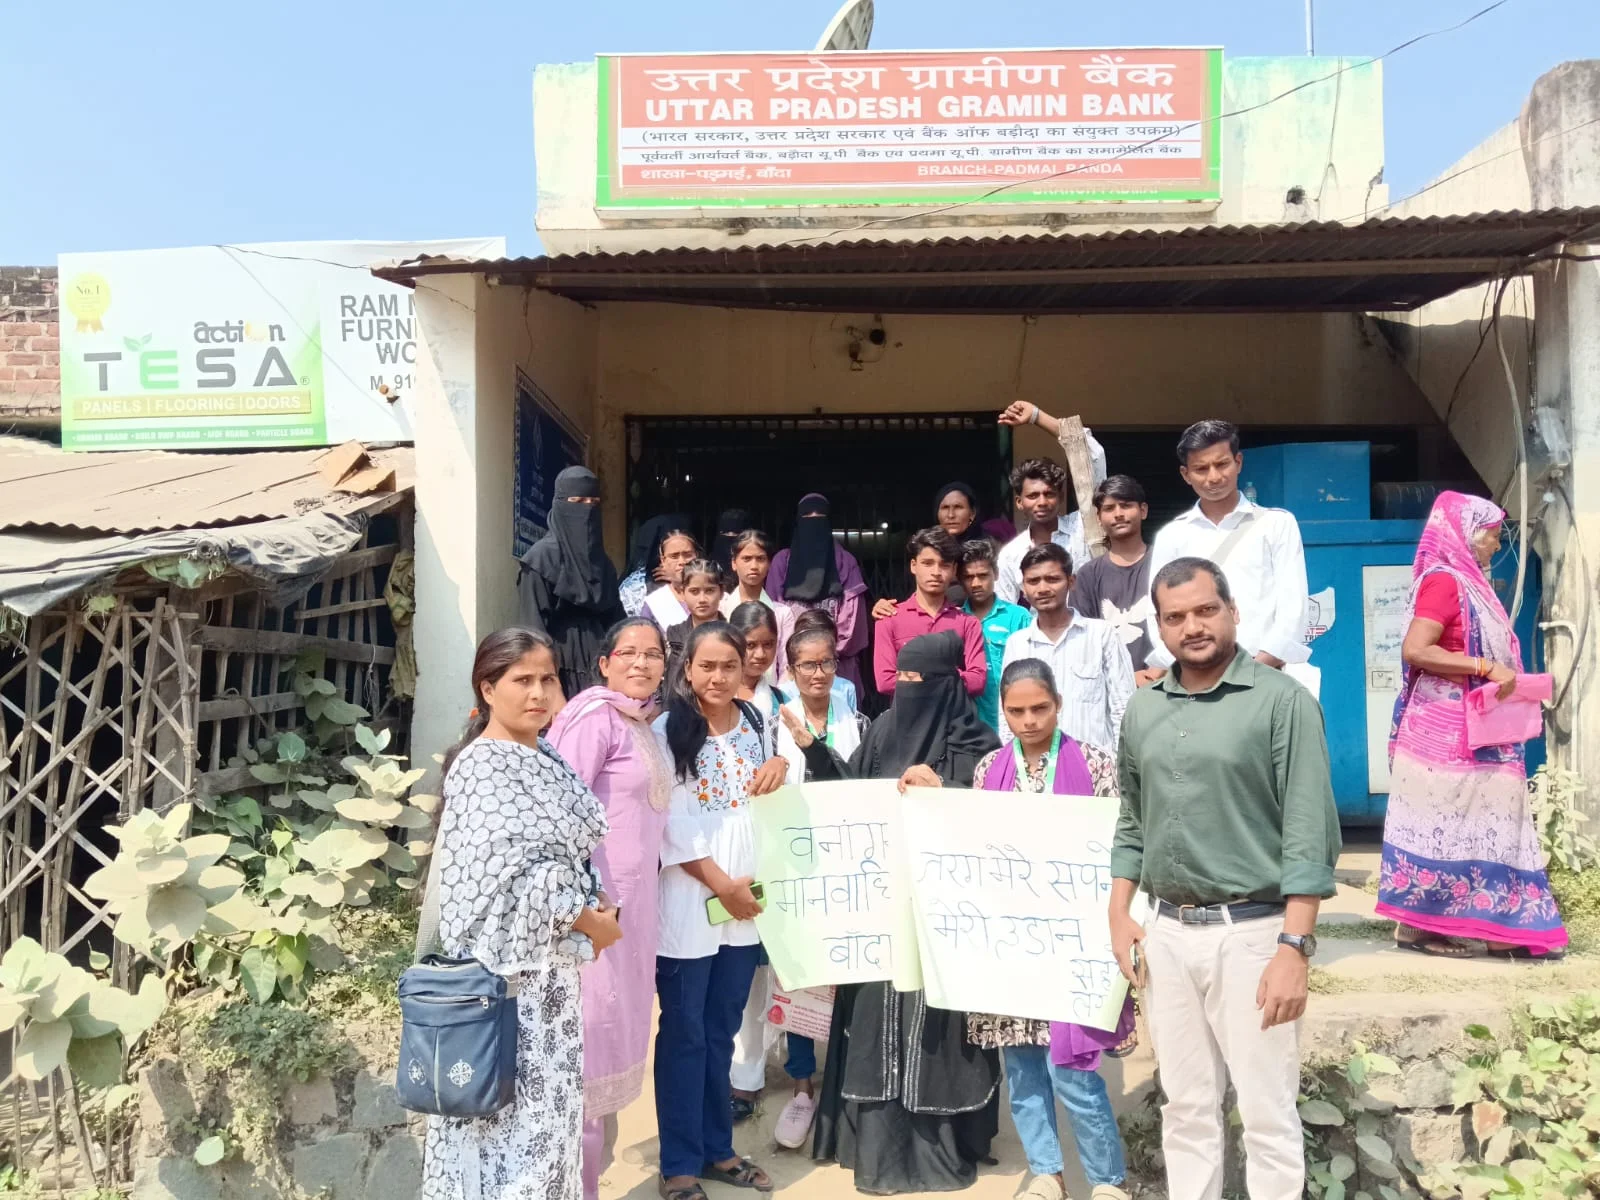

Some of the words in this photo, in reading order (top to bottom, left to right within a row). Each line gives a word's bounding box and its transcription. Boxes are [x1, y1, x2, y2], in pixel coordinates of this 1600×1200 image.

[644, 69, 751, 92] उत्तर
[763, 54, 887, 94] प्रदेश
[901, 56, 1066, 90] ग्रामीण
[1080, 54, 1176, 88] बैंक
[646, 98, 754, 122] UTTAR
[770, 96, 921, 120] PRADESH
[938, 94, 1067, 118] GRAMIN
[1082, 93, 1174, 117] BANK
[755, 131, 788, 141] उत्तर
[794, 128, 830, 141] प्रदेश
[837, 129, 887, 140] सरकार
[893, 128, 915, 140] एवं
[922, 126, 948, 139] बैंक
[1046, 126, 1067, 137] का
[1072, 124, 1120, 139] संयुक्त
[1065, 147, 1082, 156] का
[1066, 162, 1123, 174] BANDA
[340, 294, 398, 317] RAM
[84, 346, 297, 392] TESA
[394, 373, 416, 390] 91
[82, 399, 142, 414] PANELS
[155, 397, 235, 412] FLOORING
[246, 395, 301, 410] DOORS
